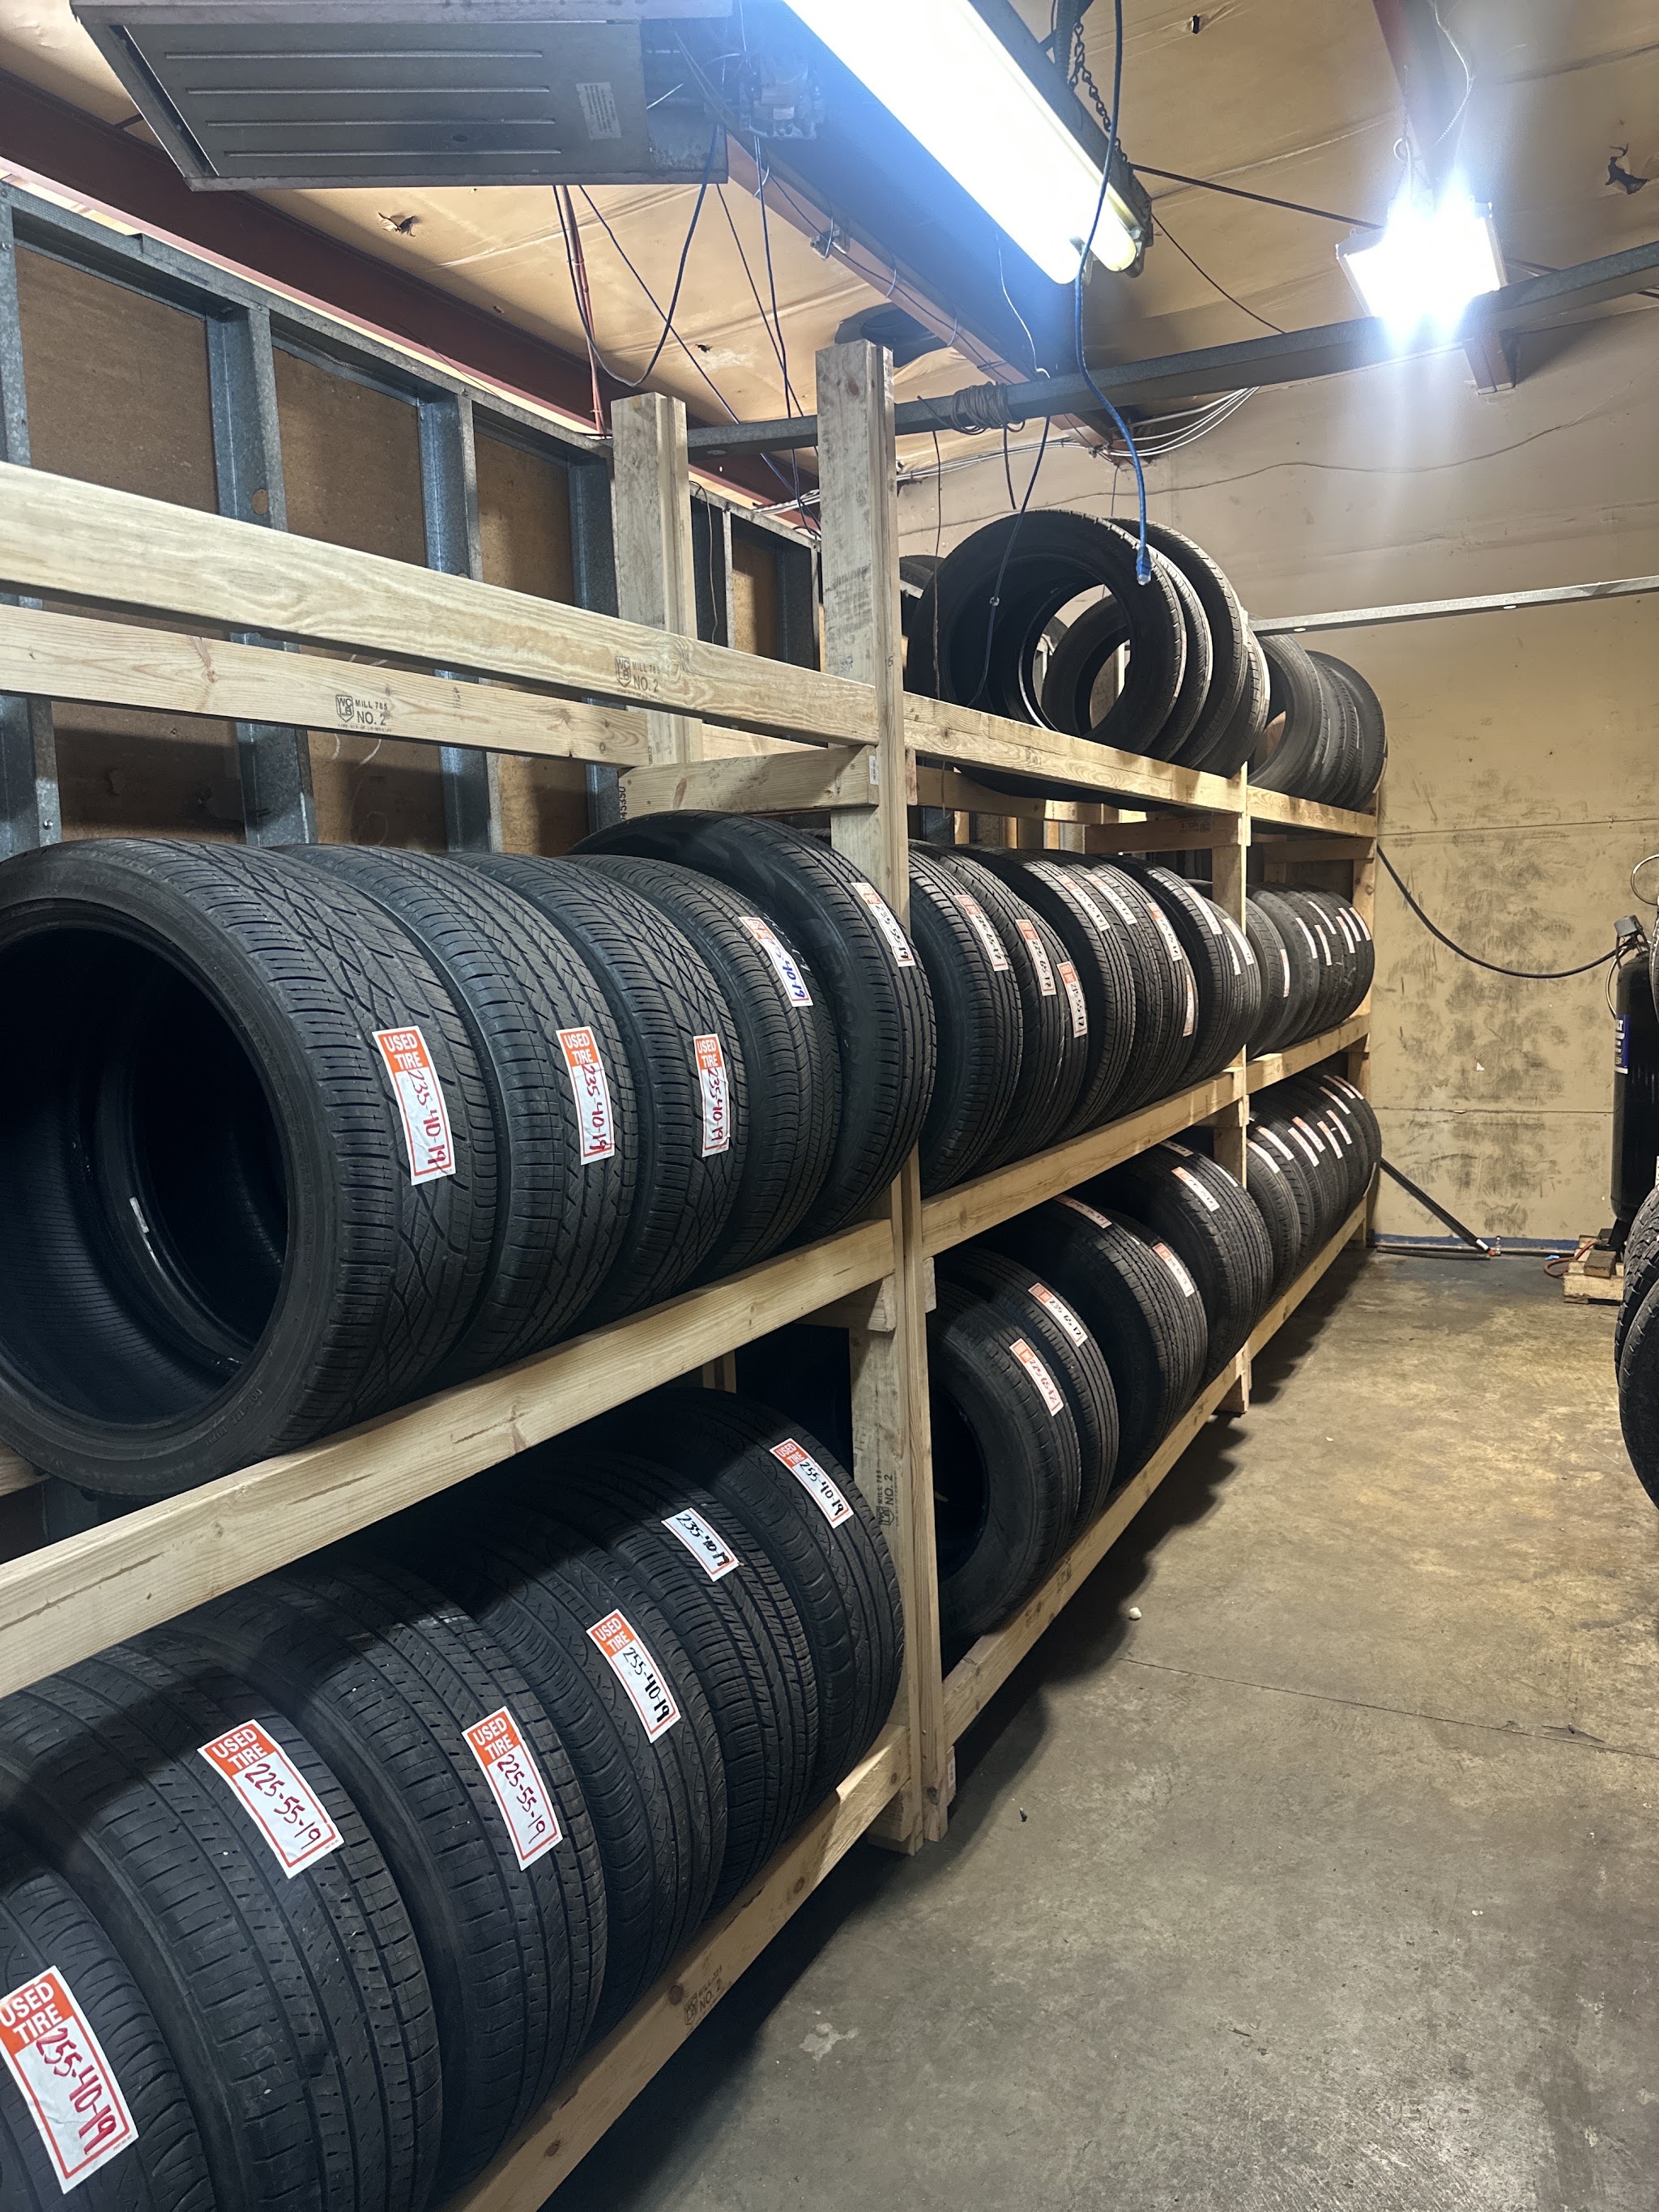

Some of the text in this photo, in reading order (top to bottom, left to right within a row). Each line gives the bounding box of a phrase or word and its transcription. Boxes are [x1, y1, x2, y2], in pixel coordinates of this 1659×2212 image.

[633, 662, 647, 672] MILL
[633, 675, 659, 693] NO. 2
[356, 699, 373, 710] MILL
[356, 710, 386, 726] NO. 2
[383, 1033, 418, 1052] USED
[564, 1033, 590, 1049] USED
[697, 1040, 716, 1053] USED
[394, 1051, 423, 1070] TIRE
[572, 1049, 594, 1064] TIRE
[702, 1055, 719, 1068] TIRE
[407, 1069, 446, 1165] 235-40-19
[582, 1063, 606, 1151] 235-40-19
[776, 1443, 797, 1457] USED
[787, 1451, 805, 1465] TIRE
[800, 1461, 844, 1516] 255-40-19
[885, 1485, 893, 1505] NO.
[595, 1617, 622, 1641] USED
[607, 1630, 630, 1652] TIRE
[623, 1647, 670, 1723] 255-40-19
[472, 1717, 507, 1745] USED
[211, 1728, 258, 1758] USED
[484, 1733, 514, 1760] TIRE
[228, 1743, 268, 1770] TIRE
[244, 1762, 322, 1850] 225-55-19
[497, 1754, 546, 1844] 225-55-19
[0, 1982, 54, 2027] USED
[13, 2003, 63, 2044] TIRE
[36, 2027, 117, 2155] 255-40-19
